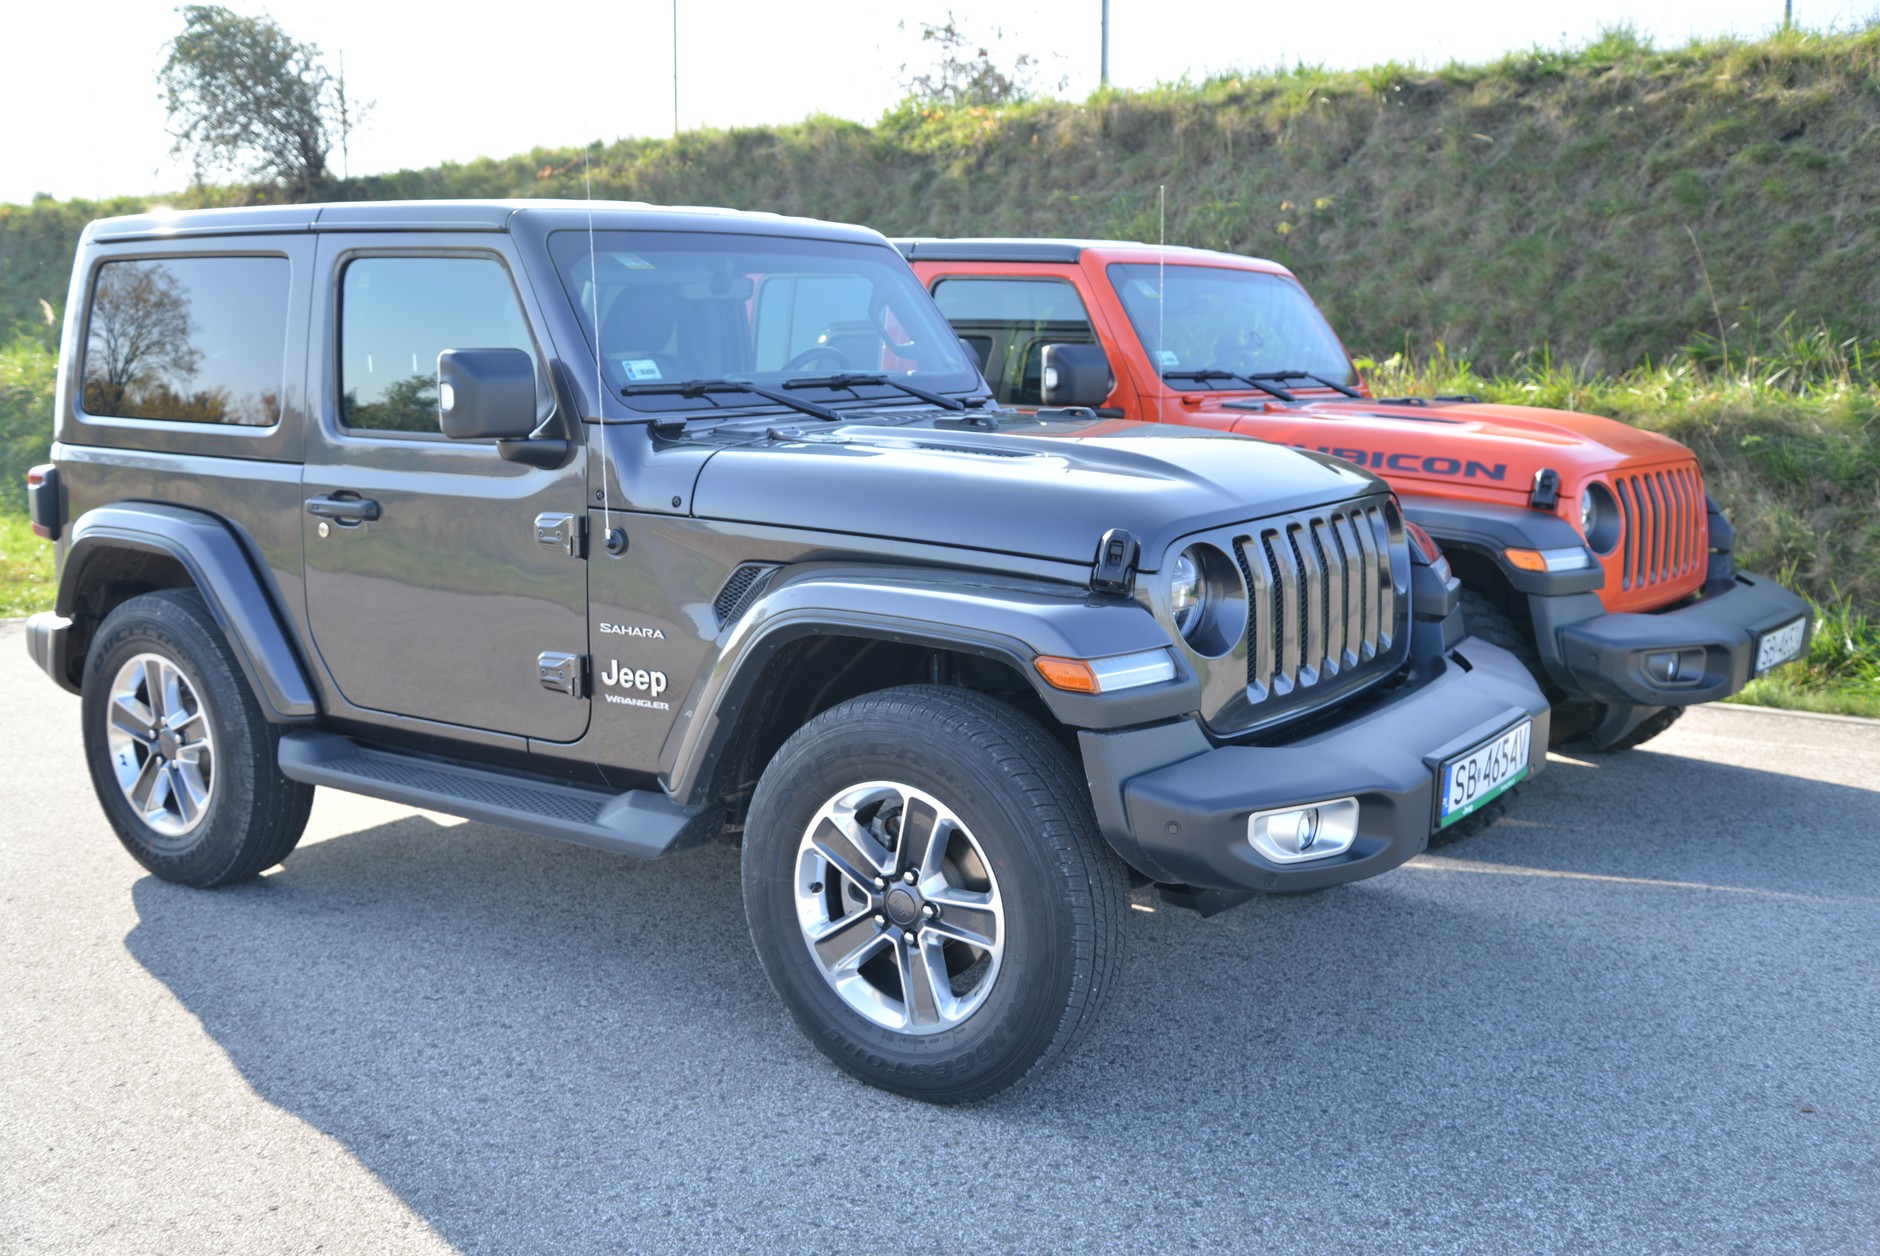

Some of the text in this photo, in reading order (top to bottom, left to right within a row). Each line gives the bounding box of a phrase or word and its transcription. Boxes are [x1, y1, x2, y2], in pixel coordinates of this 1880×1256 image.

[1272, 442, 1508, 481] BICON
[600, 622, 665, 639] SAHARA
[601, 659, 667, 697] Jeep
[605, 693, 669, 711] WRANGLER
[1454, 726, 1528, 805] SB 4654V
